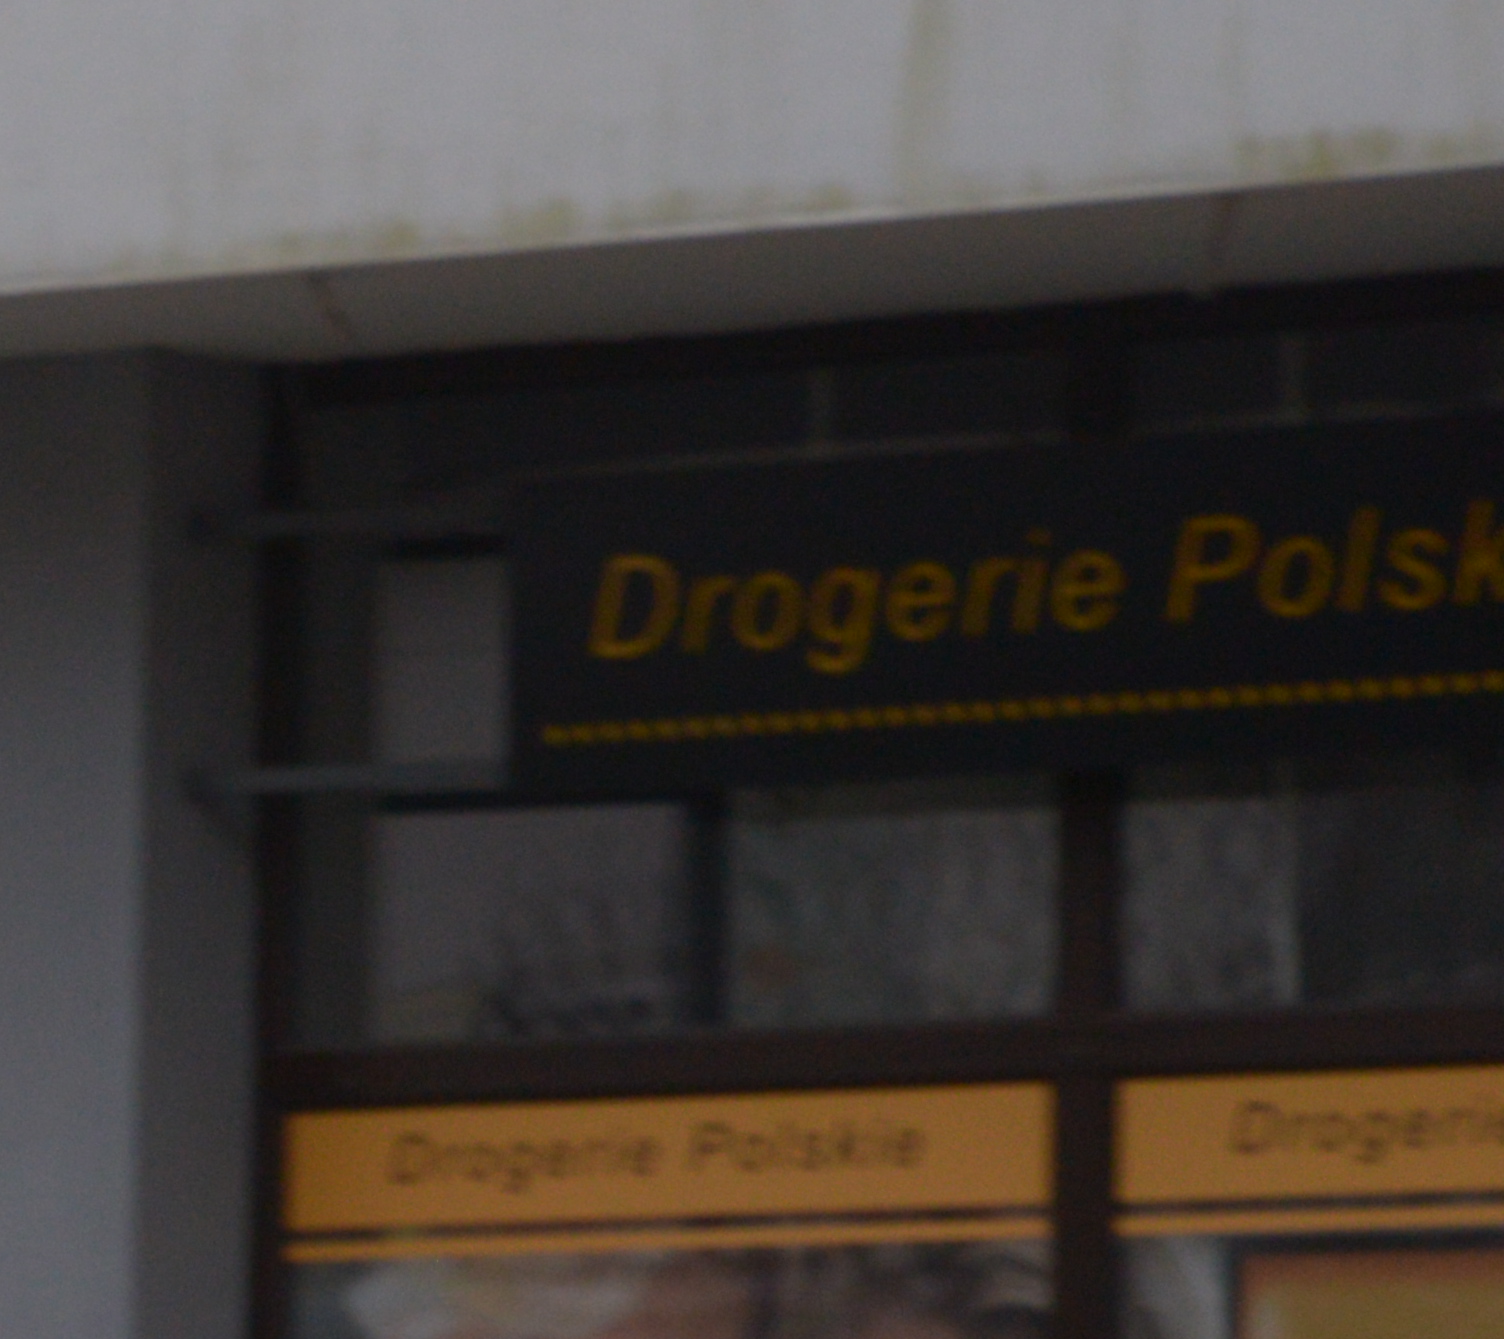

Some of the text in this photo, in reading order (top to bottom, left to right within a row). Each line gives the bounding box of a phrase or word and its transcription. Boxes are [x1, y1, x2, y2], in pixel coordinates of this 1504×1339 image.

[589, 525, 1129, 675] Drogerie
[389, 1116, 926, 1195] Drogerie Polskie
